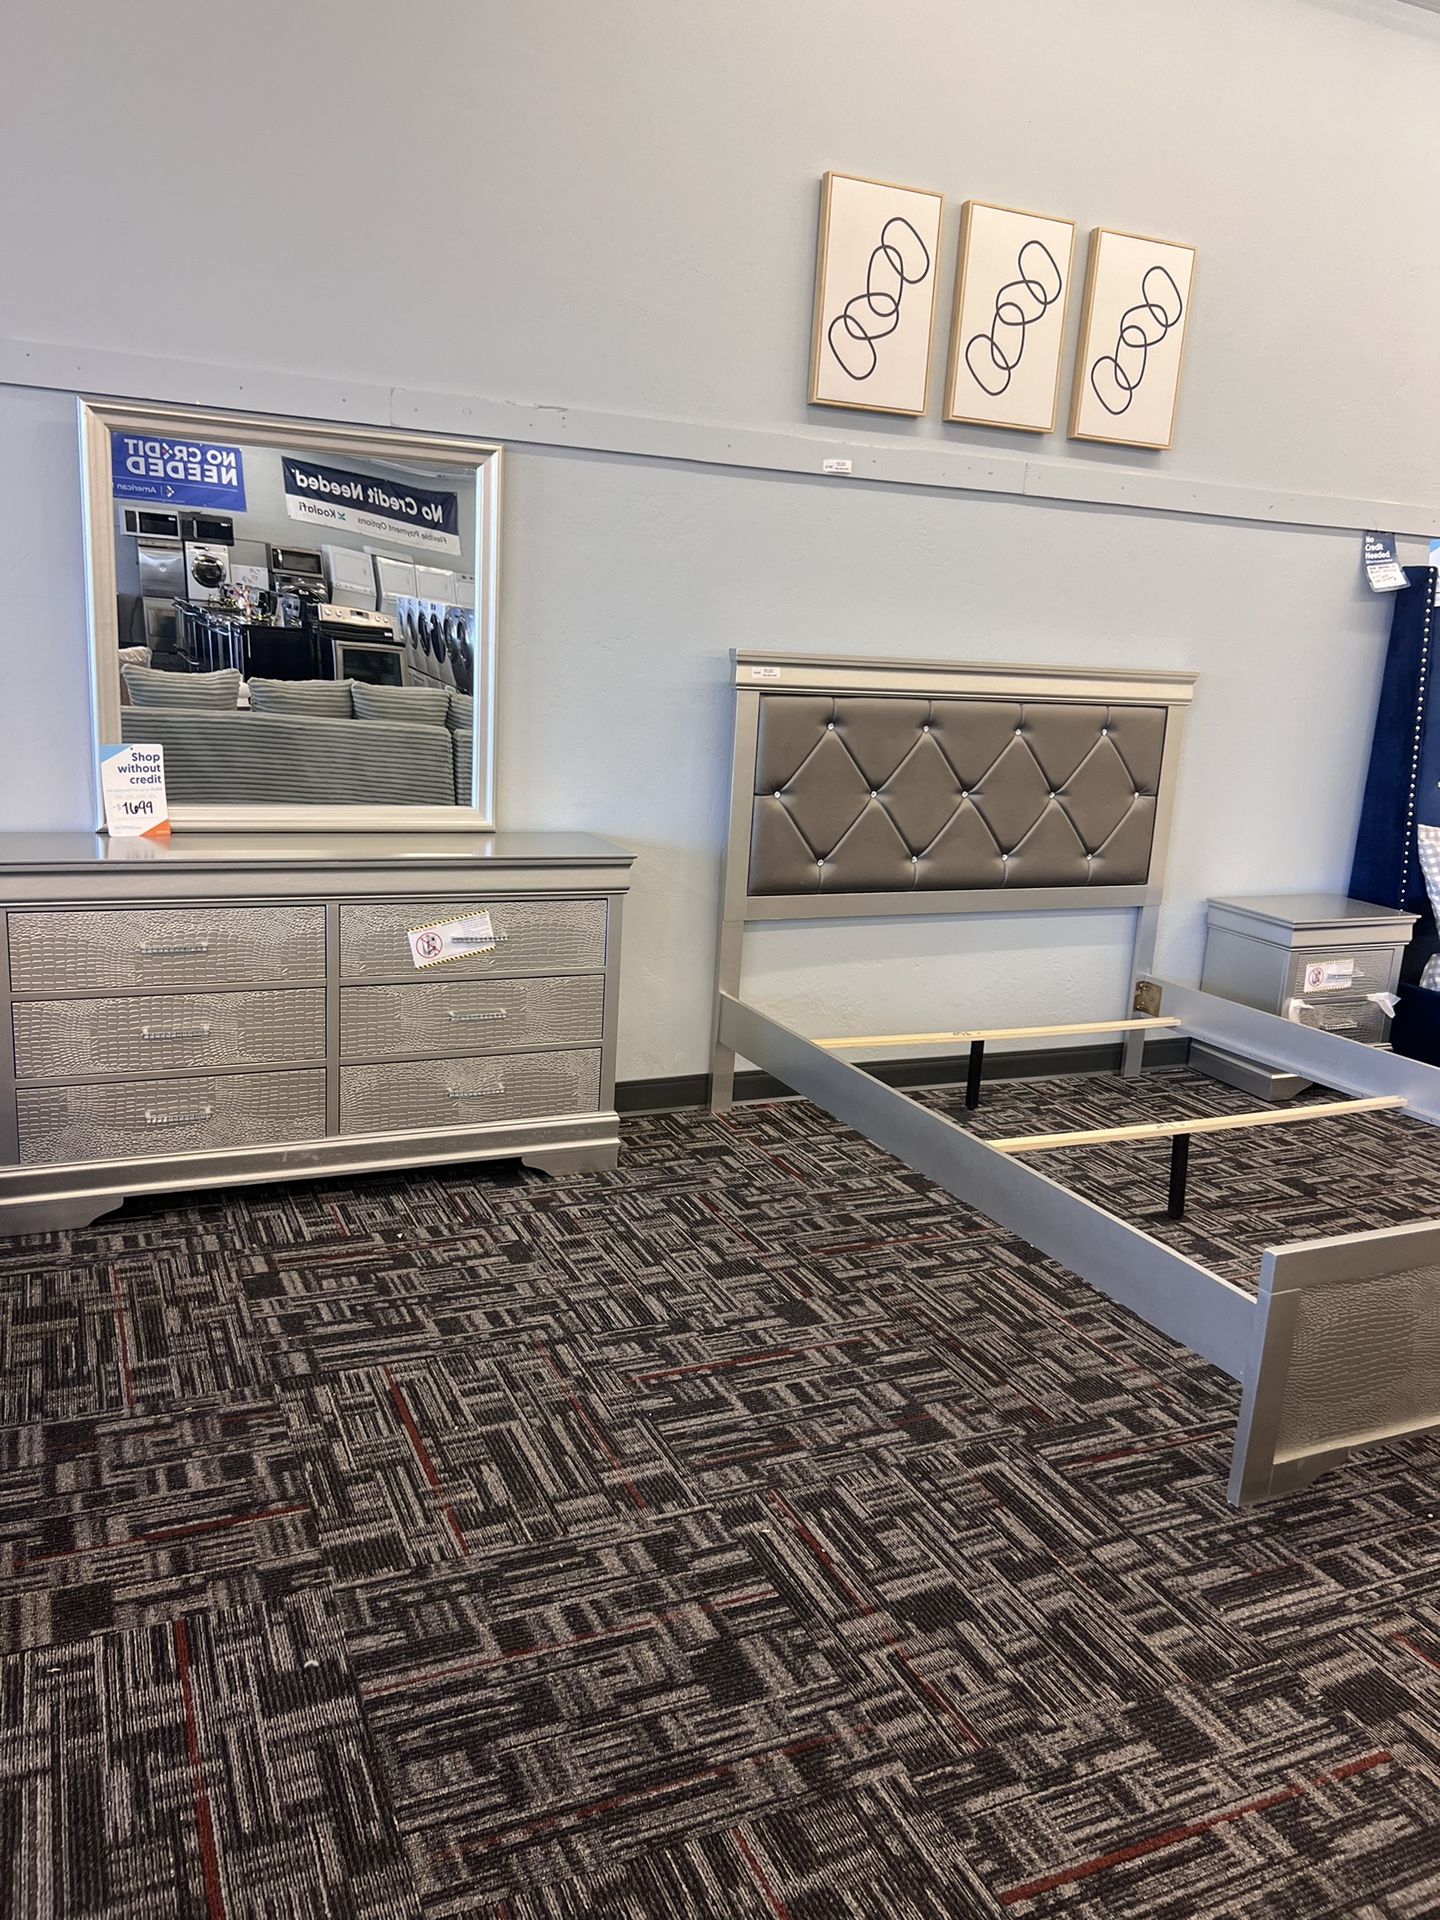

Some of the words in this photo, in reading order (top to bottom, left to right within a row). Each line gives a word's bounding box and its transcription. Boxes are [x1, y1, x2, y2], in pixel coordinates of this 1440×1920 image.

[1365, 535, 1374, 543] No
[1365, 543, 1384, 551] Credit
[1365, 551, 1391, 559] Needed
[131, 752, 161, 763] Shop
[117, 763, 161, 773] without
[130, 774, 162, 784] credit
